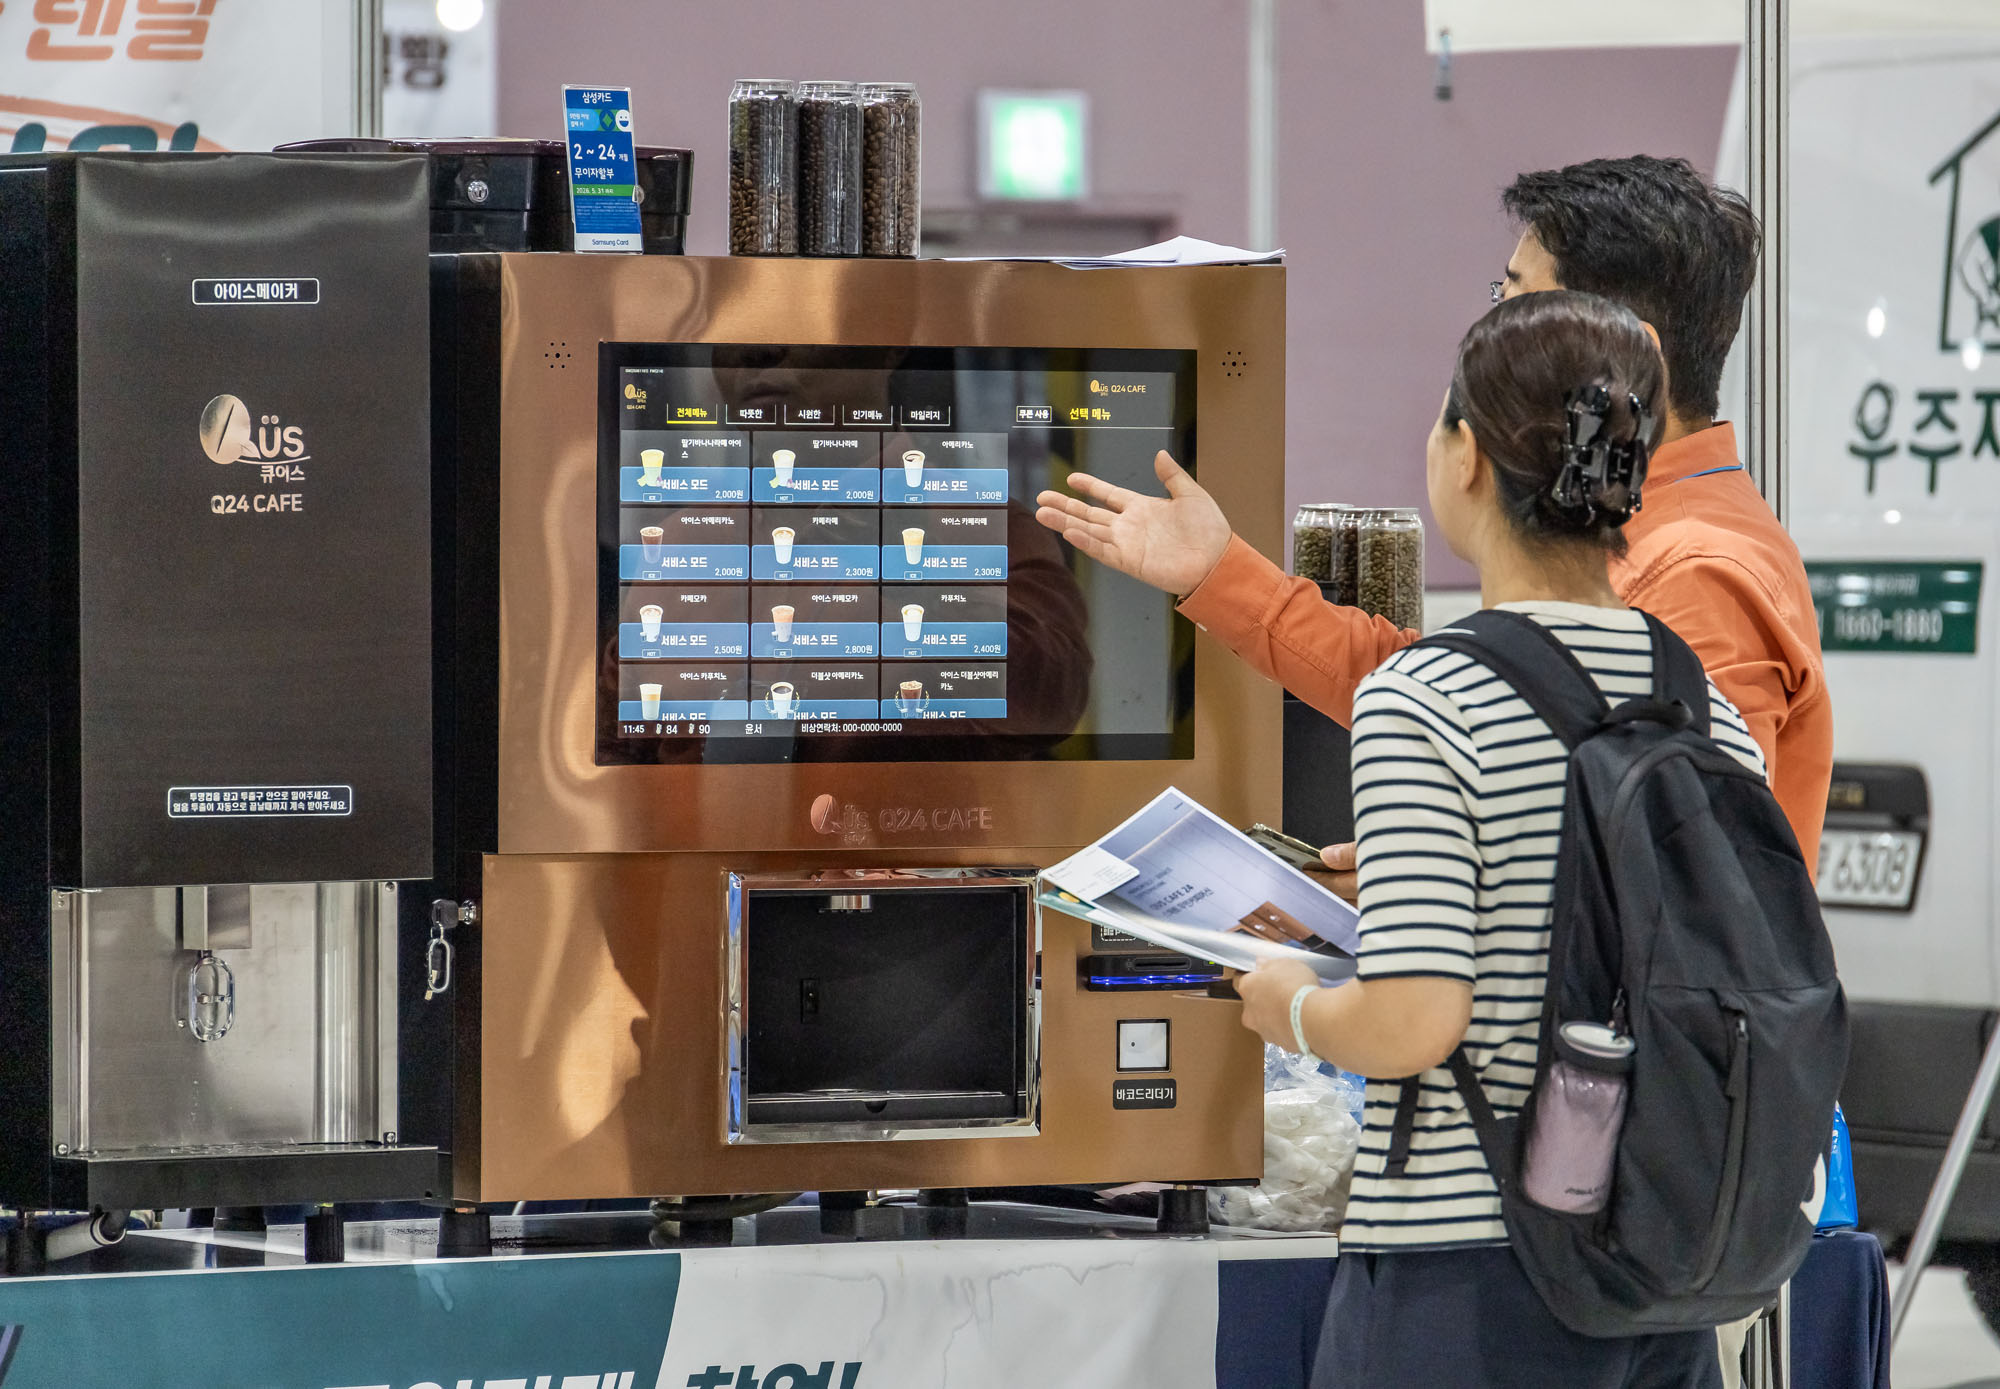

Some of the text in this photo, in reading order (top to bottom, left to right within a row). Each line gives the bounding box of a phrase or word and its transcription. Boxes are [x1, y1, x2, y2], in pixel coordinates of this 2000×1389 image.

[582, 92, 612, 104] 삼성카드
[598, 144, 616, 160] 24
[574, 167, 614, 180] 무이자할부
[214, 282, 298, 300] 아이스메이커
[1111, 385, 1146, 393] Q24 CAFE
[676, 407, 708, 418] 전체메뉴
[739, 408, 763, 419] 따뜻한
[798, 409, 821, 420] 시원한
[852, 410, 883, 420] 인기메뉴
[910, 410, 940, 421] 마일리지
[1018, 409, 1050, 419] 쿠폰 사용
[1069, 408, 1111, 421] 선택 메뉴
[942, 440, 974, 449] 아메리카노
[260, 465, 305, 483] 큐어스
[691, 479, 708, 490] 모드
[793, 480, 839, 491] 서비스 모드
[923, 480, 968, 491] 서비스 모드
[715, 490, 744, 499] 2,000원
[846, 490, 874, 500] 2,000원
[975, 491, 1002, 500] 1,500원
[211, 493, 303, 514] Q24 CAFE
[681, 517, 701, 525] 아이스
[941, 517, 960, 526] 아이스
[661, 557, 708, 568] 서비스 모드
[793, 557, 839, 568] 서비스 모드
[922, 557, 968, 568] 서비스 모드
[714, 567, 743, 577] 2,000원
[845, 567, 873, 577] 2,300원
[974, 567, 1002, 577] 2,300원
[812, 594, 831, 603] 아이스
[941, 594, 966, 603] 카푸치노
[661, 635, 707, 646] 서비스 모드
[792, 634, 838, 646] 서비스 모드
[922, 634, 967, 645] 서비스 모드
[714, 645, 742, 655] 2,500원
[845, 645, 873, 654] 2,800원
[973, 644, 1001, 654] 2,400원
[680, 672, 727, 680] 아이스 카푸치노
[940, 671, 960, 679] 아이스
[940, 682, 954, 691] 카노
[623, 724, 645, 734] 11:45
[666, 724, 678, 734] 84
[698, 724, 712, 734] 90
[745, 723, 762, 735] 윤서
[801, 723, 902, 733] 비상연락처: 000-0000-0000
[266, 791, 288, 800] 안으로
[216, 802, 247, 812] 자동으로
[290, 802, 305, 811] 계속
[879, 808, 927, 832] Q24
[932, 807, 992, 831] CAFE
[1117, 1088, 1173, 1100] 바코드리더기
